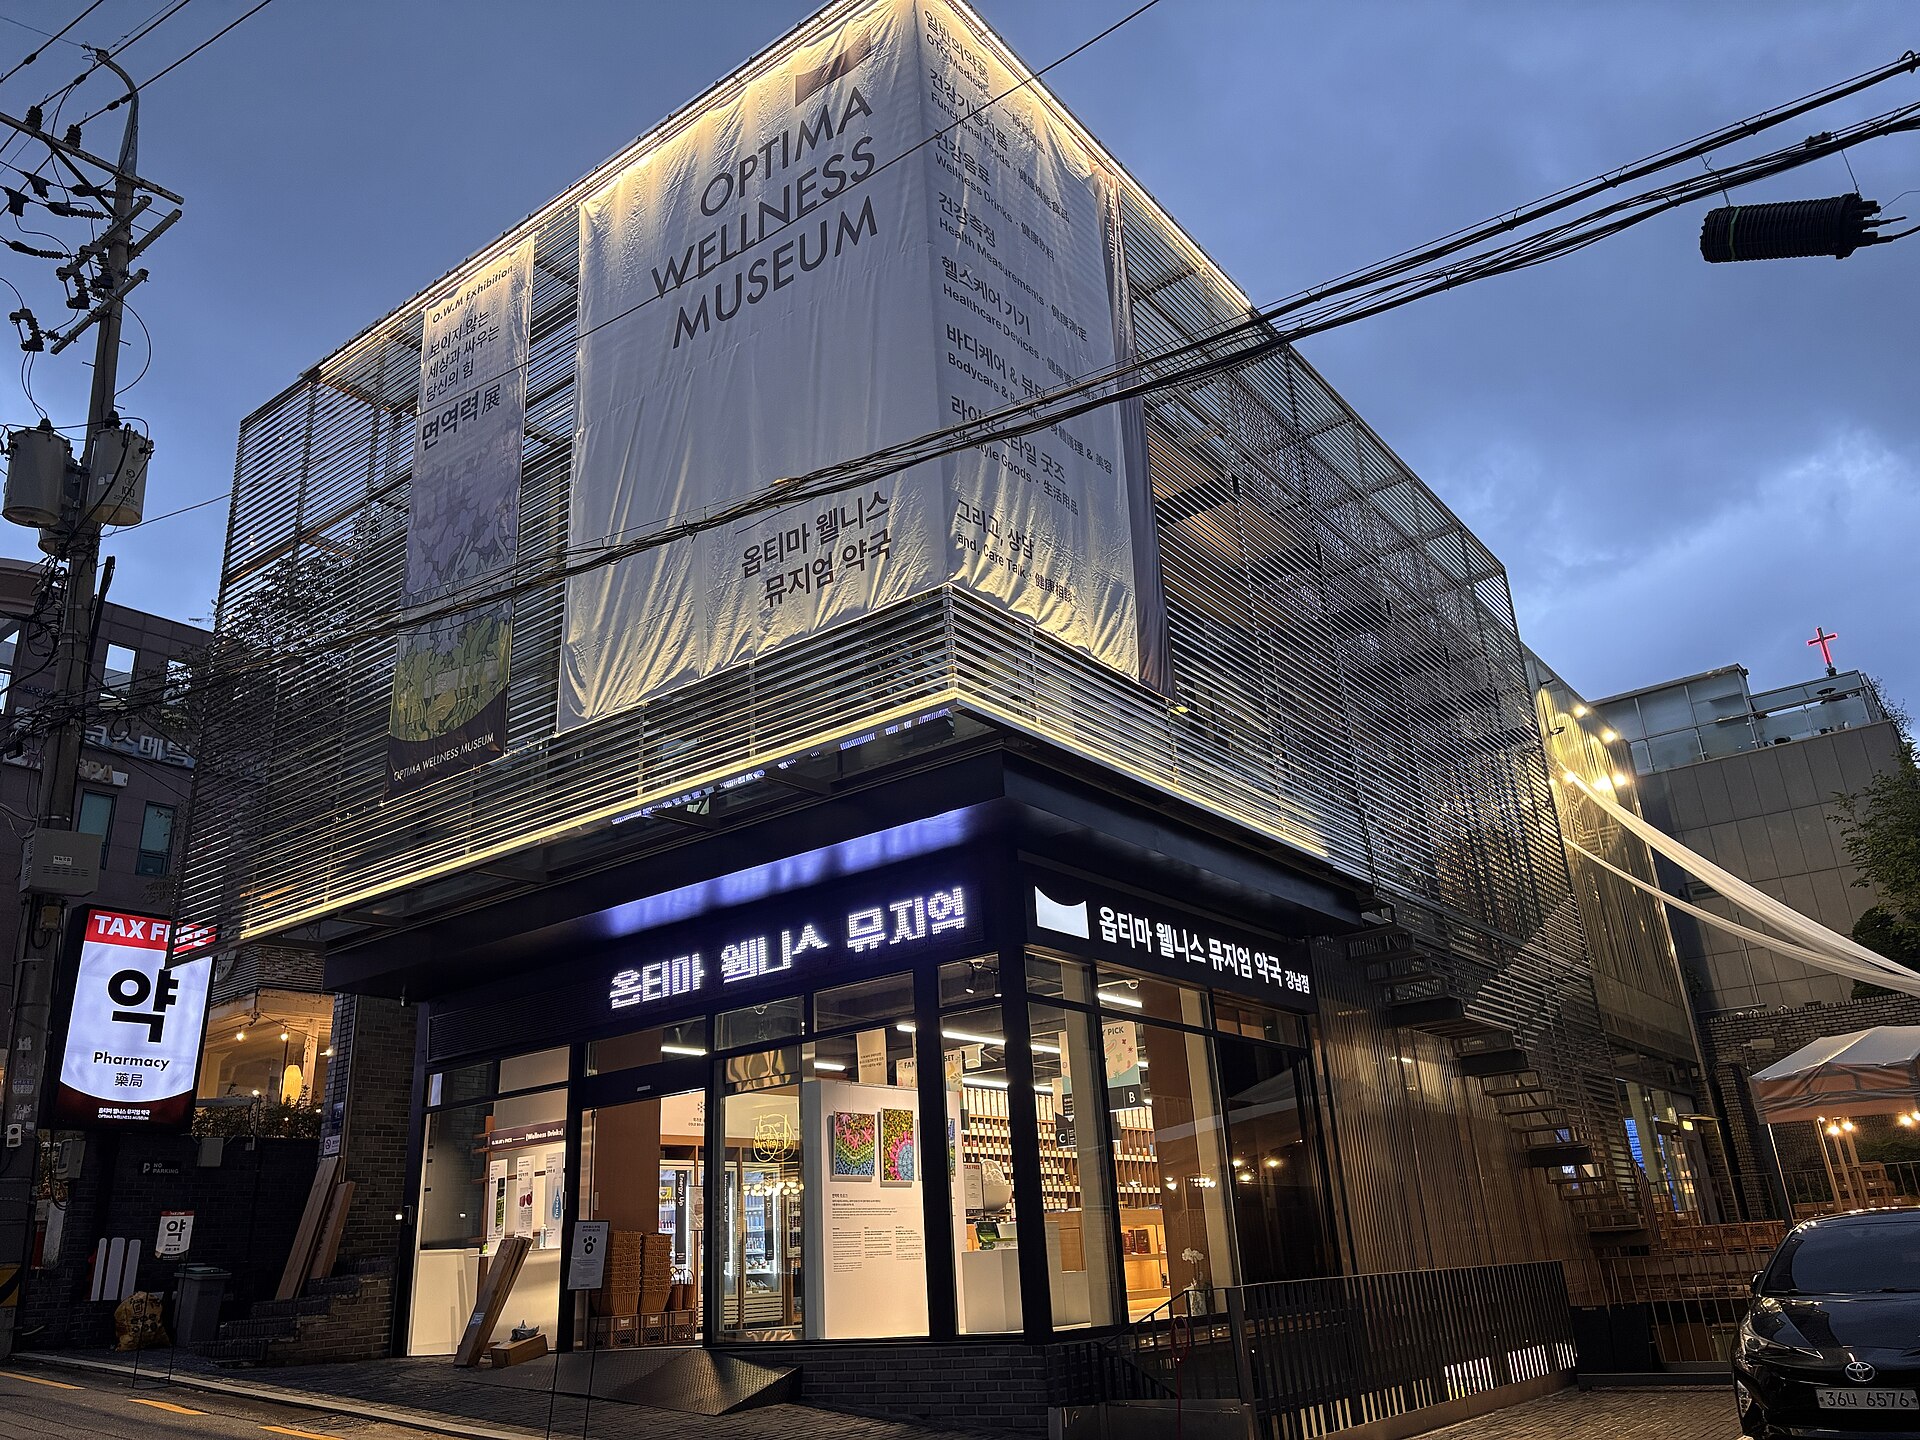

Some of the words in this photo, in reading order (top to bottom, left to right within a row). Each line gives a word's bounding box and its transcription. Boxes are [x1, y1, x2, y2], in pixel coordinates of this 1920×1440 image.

[925, 10, 989, 83] 일반의약품
[930, 68, 1008, 152] 건강기능식품
[931, 91, 983, 143] Functional
[984, 137, 1010, 169] Foods
[700, 86, 874, 217] OPTIMA
[935, 128, 992, 187] 건강음료
[935, 152, 983, 195] Wellness
[984, 191, 1013, 223] Drinks
[651, 136, 876, 299] WELLNESS
[938, 191, 996, 248] 건강측정
[465, 265, 514, 302] Exhibition
[673, 195, 878, 350] MUSEUM
[939, 217, 975, 250] Health
[977, 242, 1044, 306] Measurements
[941, 256, 1002, 313] 헬스케어
[1005, 300, 1031, 336] 기기
[943, 283, 1002, 330] Healthcare
[1002, 323, 1040, 359] Devices
[427, 347, 461, 380] 세상과
[464, 325, 500, 356] 싸우는
[430, 327, 463, 356] 보이지
[465, 311, 490, 335] 않는
[946, 323, 1007, 380] 바디케어
[1009, 366, 1018, 387] &
[426, 370, 459, 403] 당신의
[462, 358, 474, 380] 힘
[948, 351, 1000, 393] Bodycare
[1000, 385, 1009, 400] &
[421, 390, 479, 451] 면역력
[480, 383, 501, 416] 展
[1001, 453, 1033, 484] Goods
[1041, 451, 1066, 485] 굿즈
[1086, 448, 1094, 462] &
[1043, 479, 1079, 517] 生活用品
[741, 522, 811, 579] 옵티마
[815, 490, 890, 546] 웰니스
[956, 499, 1004, 546] 그리고,
[1007, 528, 1034, 560] 상담
[957, 532, 981, 556] and,
[982, 544, 1004, 567] Care
[1006, 557, 1026, 579] Talk
[764, 552, 835, 608] 뮤지엄
[842, 528, 892, 572] 약국
[393, 764, 421, 782] OPTIMA
[422, 746, 459, 771] WELLNESS
[459, 732, 494, 755] MUSEUM
[94, 914, 145, 940] TAX
[1099, 906, 1153, 953] 옵티마
[1155, 922, 1206, 964] 웰니스
[1208, 937, 1253, 979] 뮤지엄
[1254, 951, 1283, 988] 약국
[1284, 969, 1311, 995] 강남점
[107, 968, 180, 1043] 약
[1107, 1026, 1125, 1036] PICK
[93, 1051, 171, 1072] Pharmacy
[114, 1072, 143, 1088] 藥局
[1128, 1091, 1136, 1104] B
[1058, 1133, 1066, 1143] C
[678, 1196, 685, 1207] Up
[166, 1218, 187, 1242] 약
[1866, 1391, 1910, 1407] 6576
